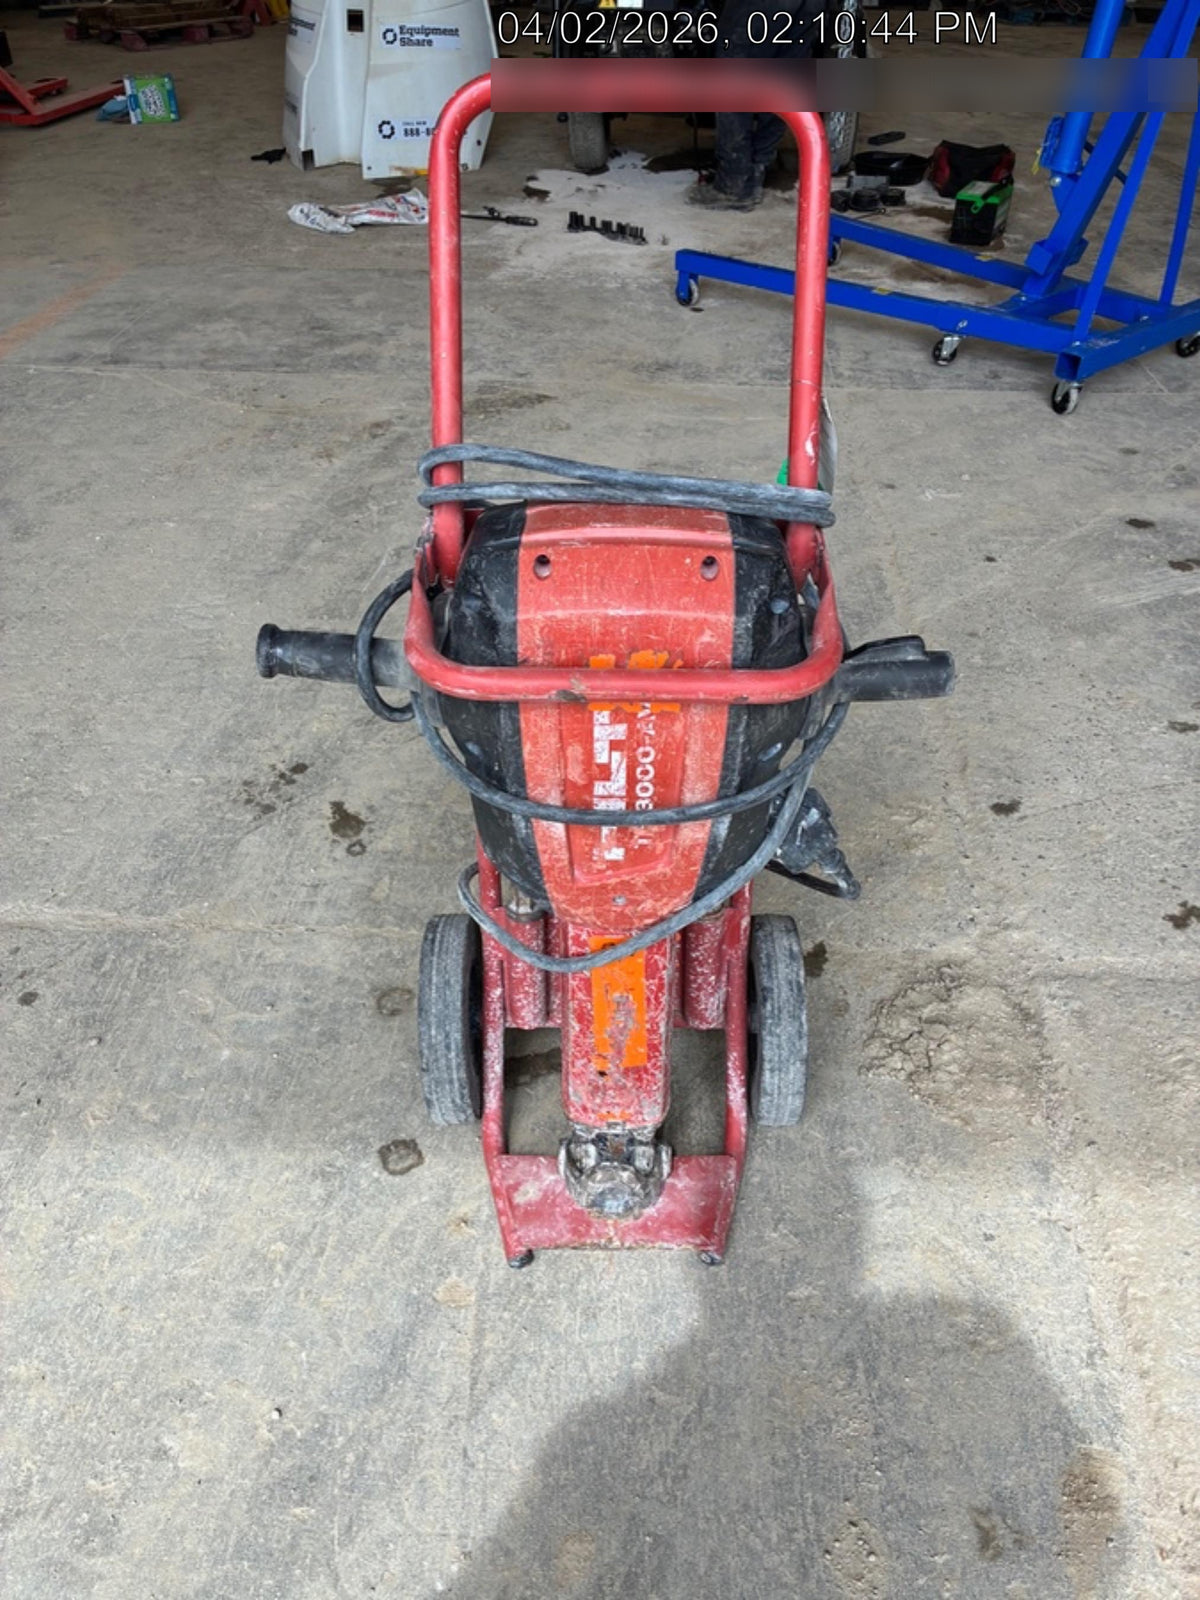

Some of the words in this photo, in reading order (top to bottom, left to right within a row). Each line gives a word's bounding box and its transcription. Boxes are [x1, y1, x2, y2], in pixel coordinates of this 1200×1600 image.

[399, 25, 459, 37] Equipment
[399, 37, 433, 47] Share
[593, 710, 627, 861] HILT
